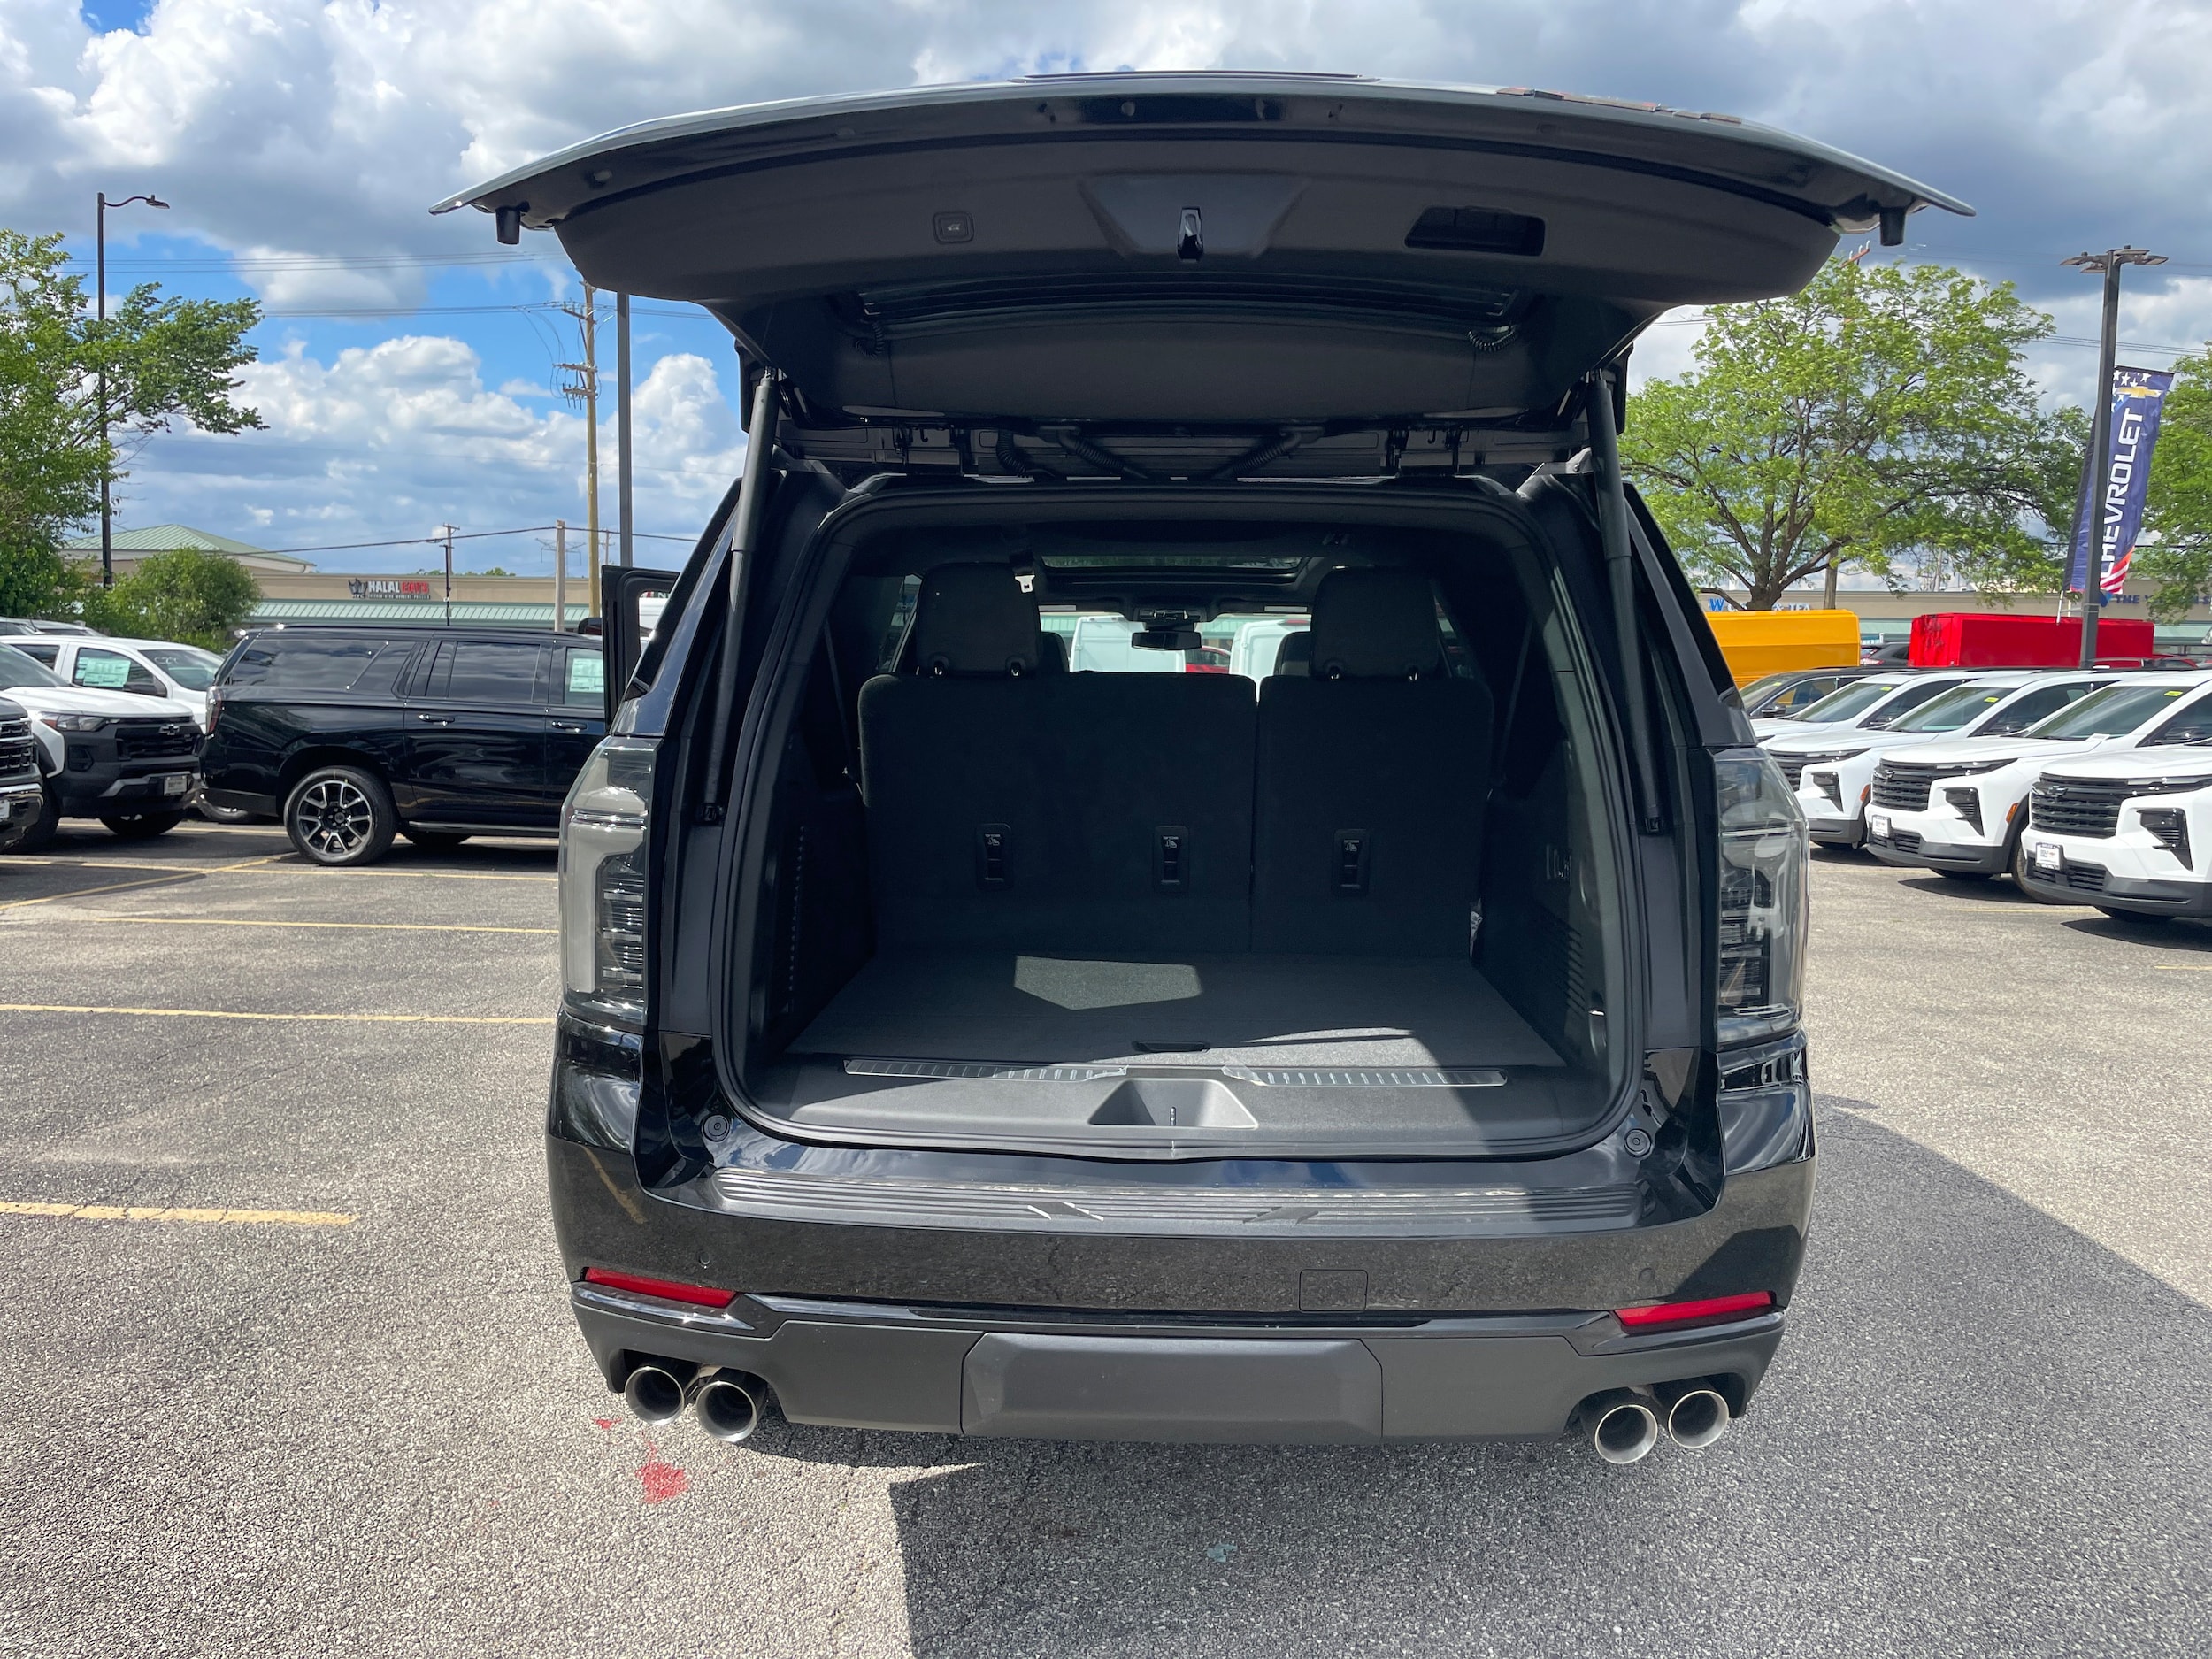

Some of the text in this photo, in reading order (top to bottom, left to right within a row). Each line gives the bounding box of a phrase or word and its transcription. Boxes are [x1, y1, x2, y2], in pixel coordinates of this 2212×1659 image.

[368, 580, 429, 594] HALAL EATS
[2116, 595, 2140, 603] THE
